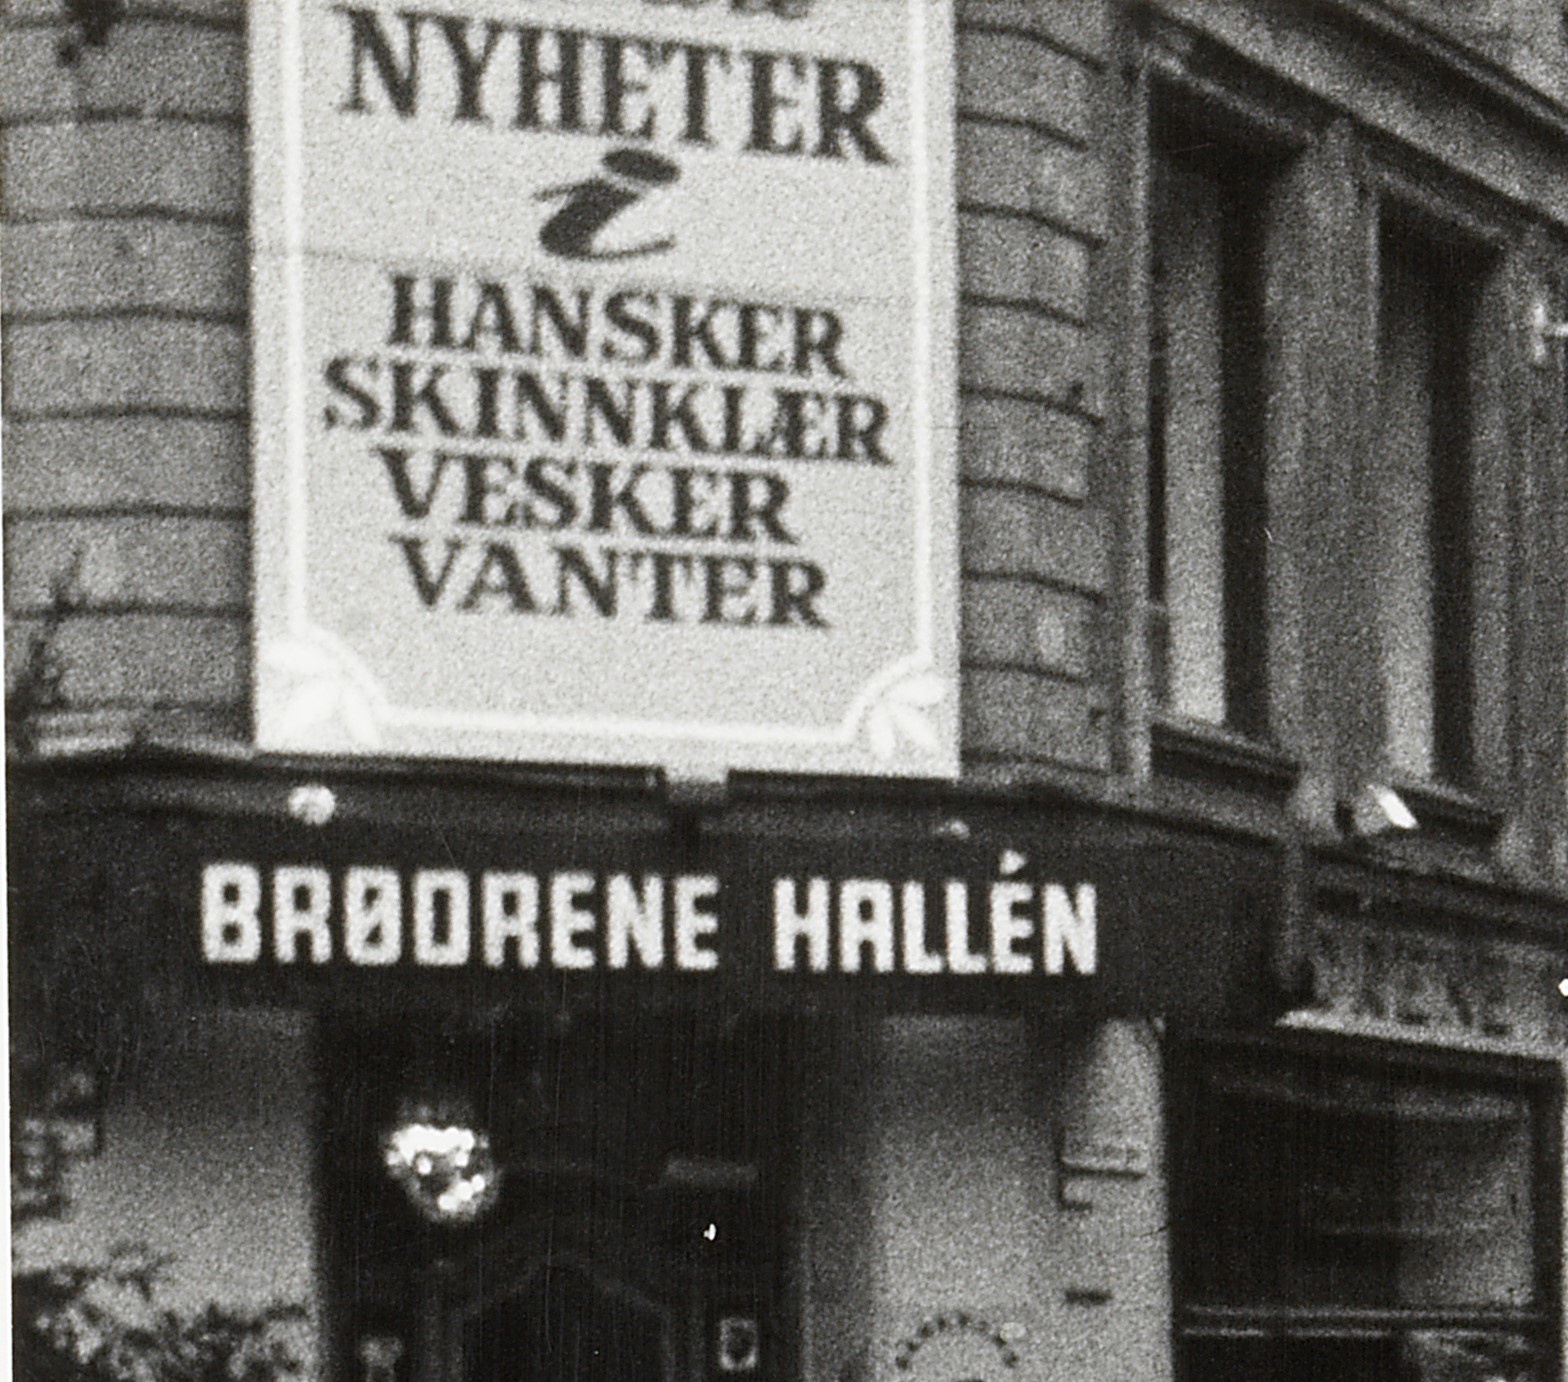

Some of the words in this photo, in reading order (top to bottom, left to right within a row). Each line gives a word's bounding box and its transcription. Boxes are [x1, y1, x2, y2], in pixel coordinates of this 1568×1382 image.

[333, 7, 895, 166] NYHETER
[386, 271, 847, 378] HANSKER
[322, 353, 894, 466] SKINNKLÆR
[371, 446, 800, 546] VESKER
[391, 534, 832, 630] VANTER
[201, 862, 720, 972] BRØDRENE
[771, 848, 1098, 975] HALLÉN
